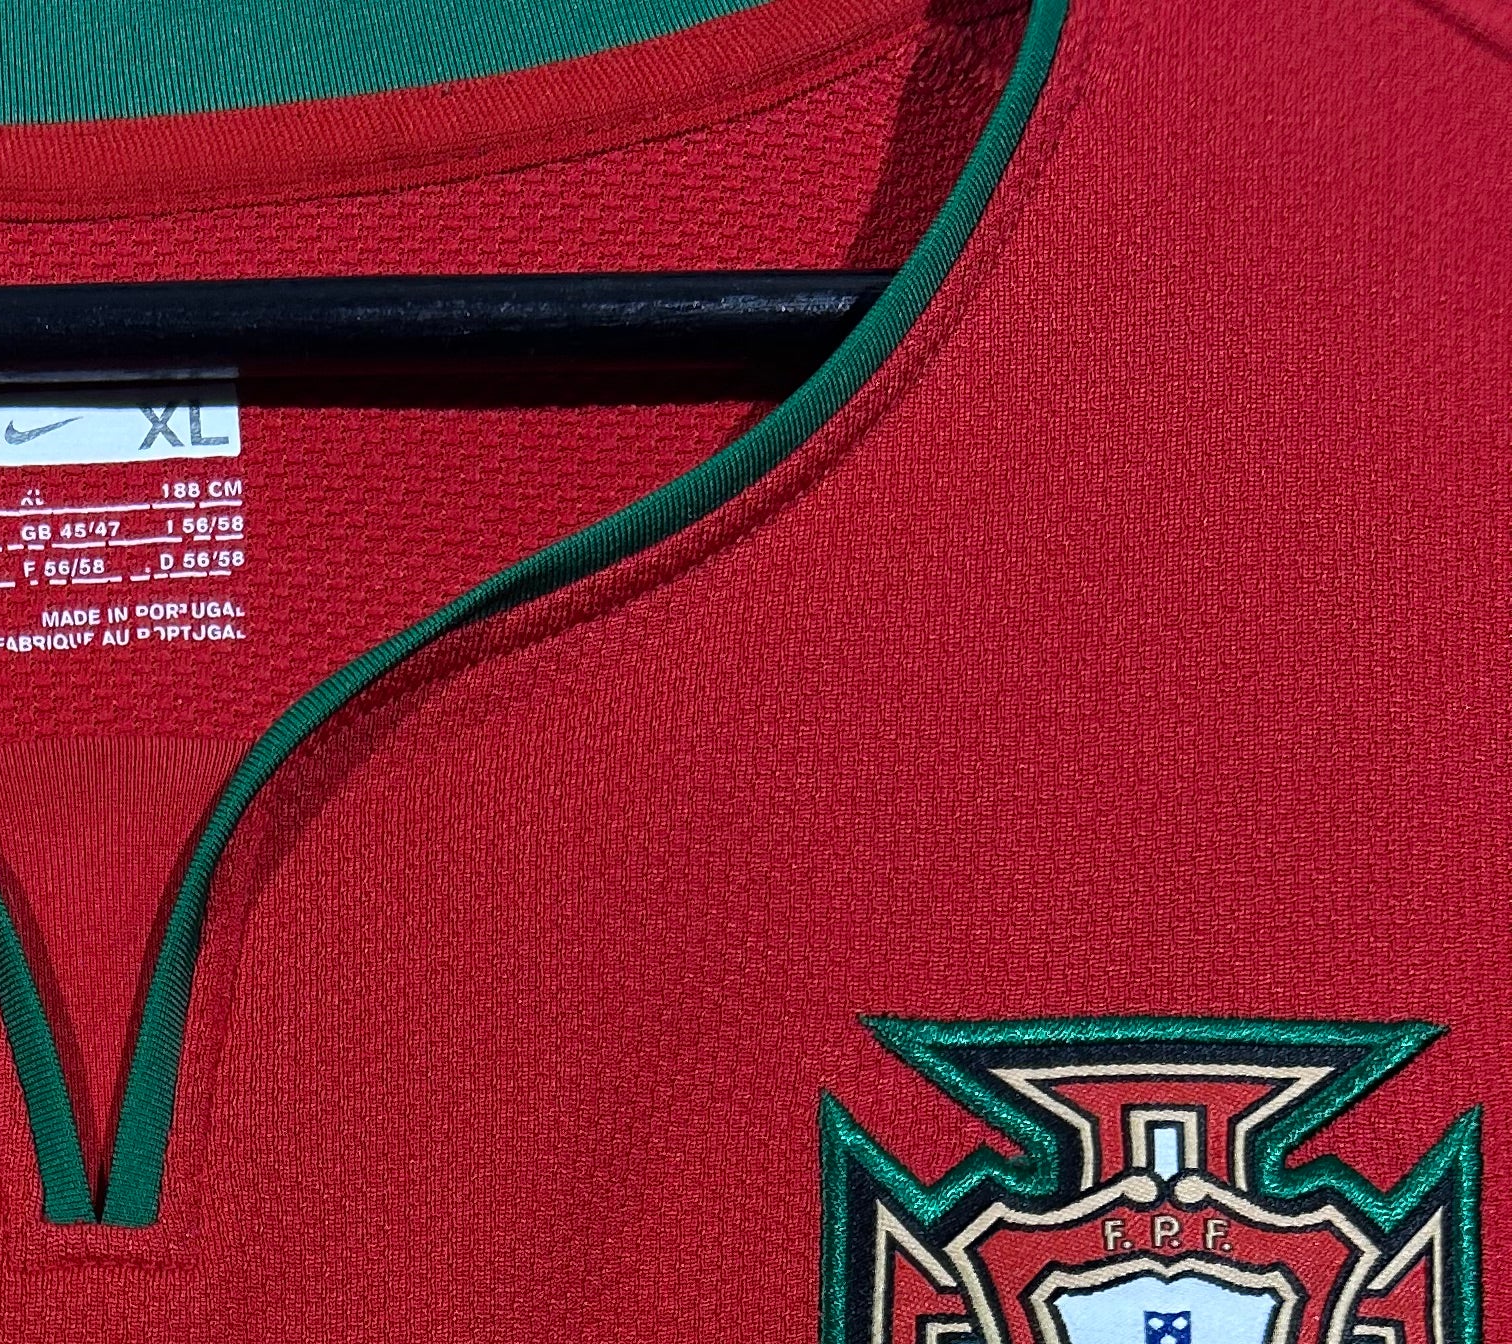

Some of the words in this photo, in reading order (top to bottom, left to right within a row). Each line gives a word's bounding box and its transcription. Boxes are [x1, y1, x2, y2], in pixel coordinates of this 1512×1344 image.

[137, 399, 230, 450] XL
[161, 482, 201, 499] 188
[207, 480, 243, 498] CM
[20, 524, 52, 542] GB
[182, 514, 244, 534] 56/58
[23, 560, 36, 578] F
[43, 557, 105, 578] 56/58
[159, 553, 174, 571] D
[41, 608, 101, 628] MADE
[107, 606, 128, 624] IN
[101, 628, 130, 646] AU
